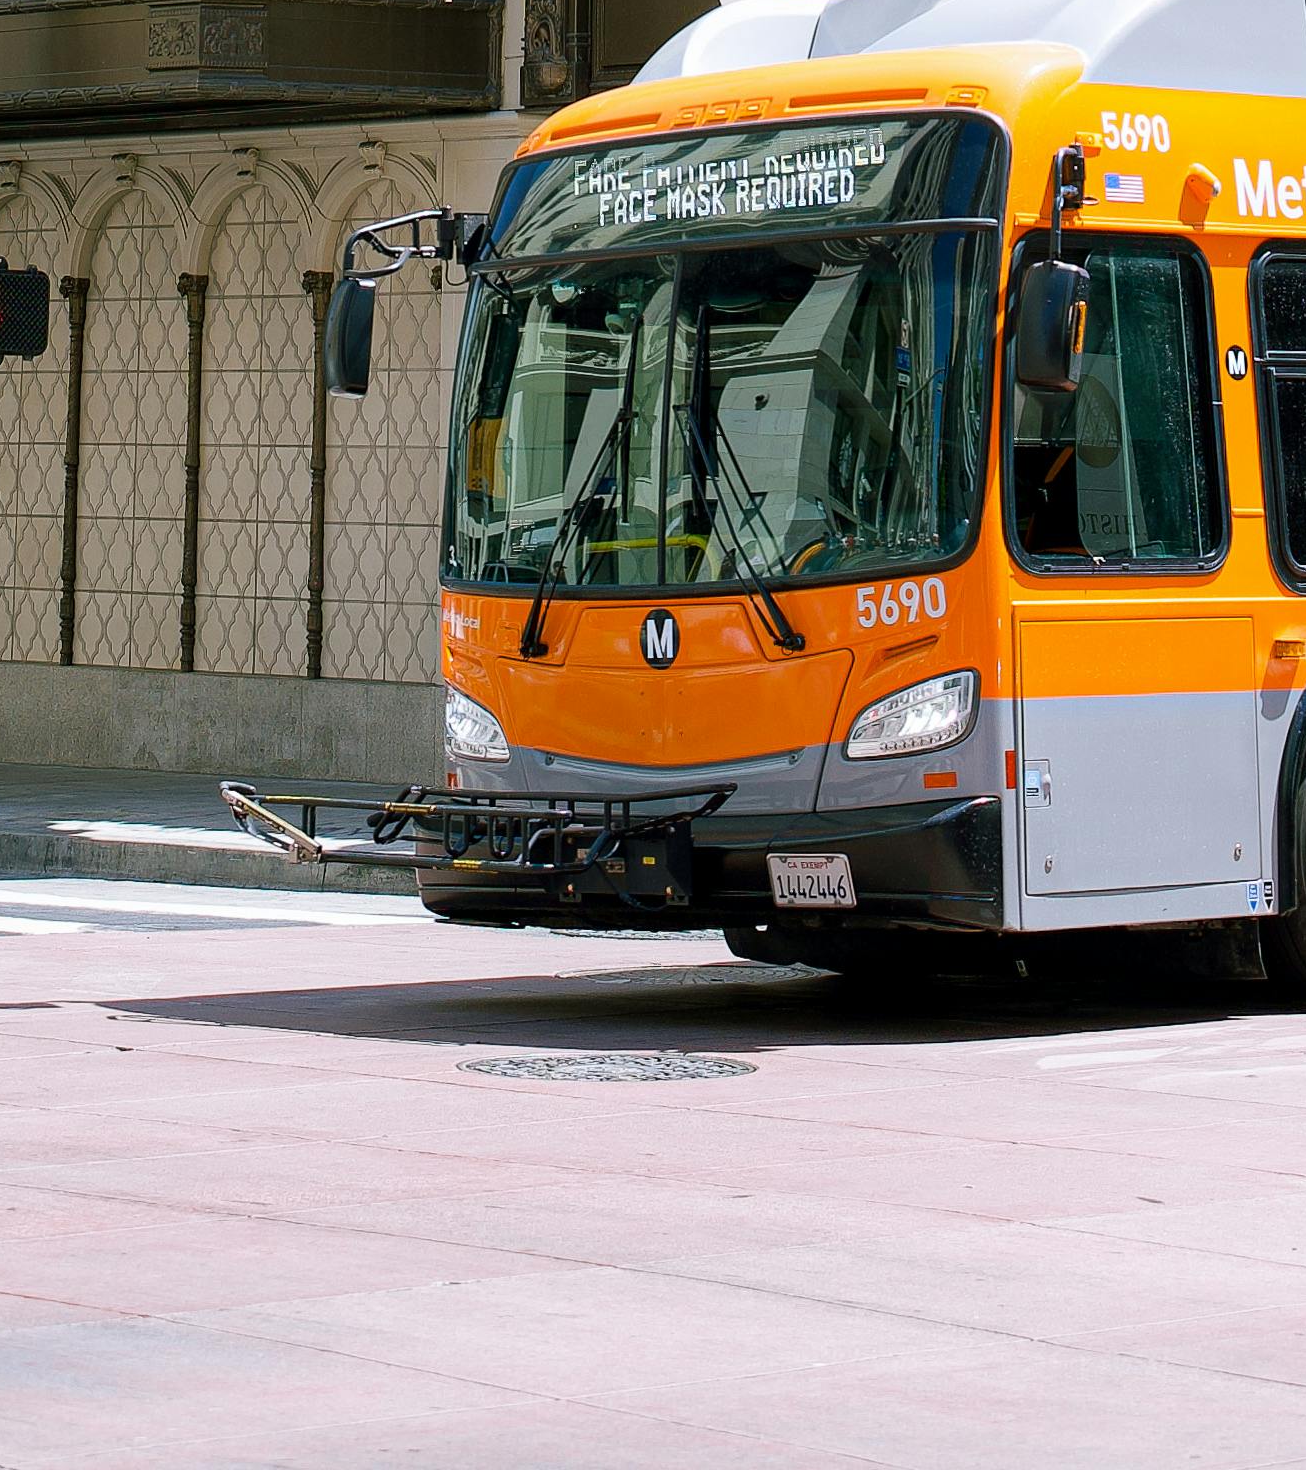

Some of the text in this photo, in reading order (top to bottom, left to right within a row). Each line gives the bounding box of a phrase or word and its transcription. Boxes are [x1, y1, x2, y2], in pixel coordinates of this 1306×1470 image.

[1102, 111, 1171, 154] 5690
[598, 167, 856, 227] FACE MASK REQUIRED
[856, 577, 948, 629] 5690
[646, 616, 675, 660] M
[776, 874, 848, 900] 1442446
